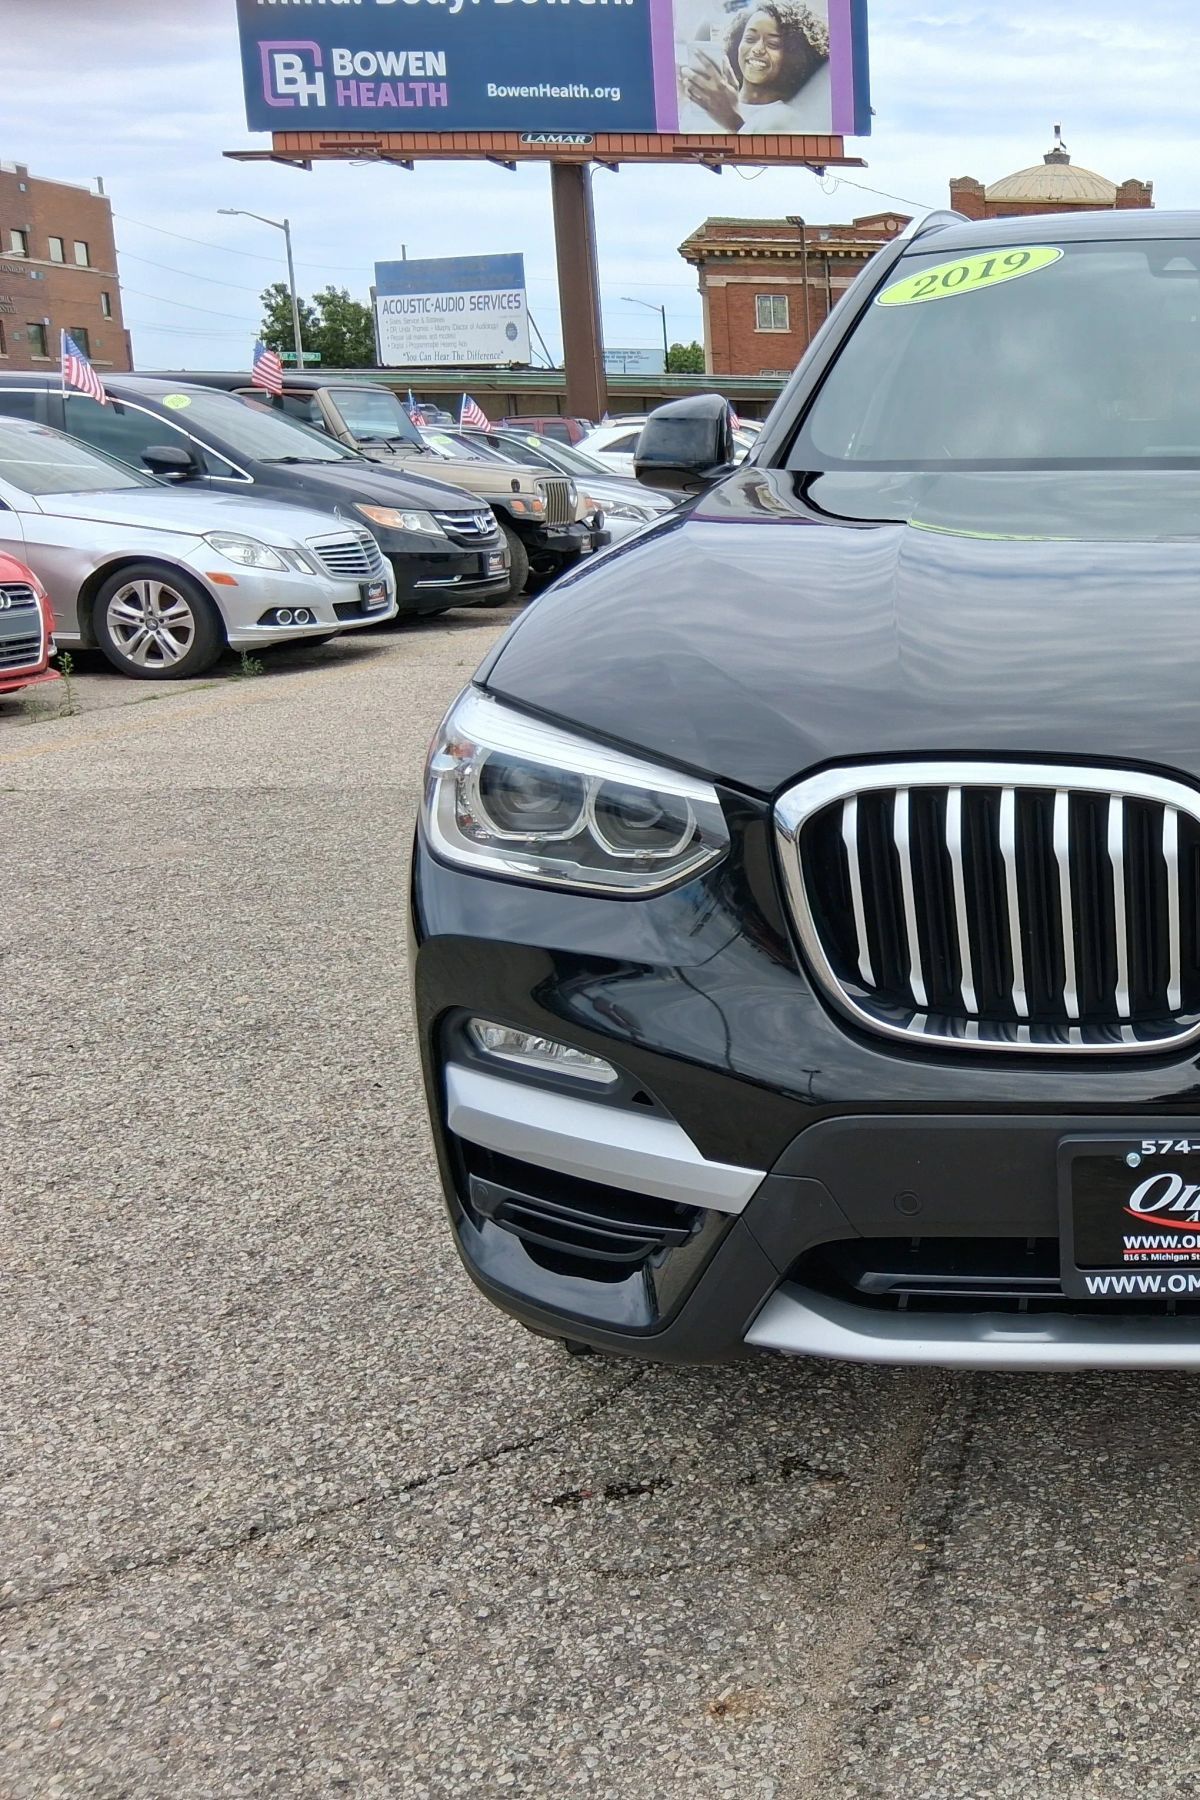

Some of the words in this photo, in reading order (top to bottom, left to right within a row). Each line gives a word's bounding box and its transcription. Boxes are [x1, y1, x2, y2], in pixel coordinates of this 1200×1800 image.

[331, 48, 447, 76] BOWEN
[336, 79, 448, 107] HEALTH
[487, 83, 621, 101] BowenHealth.org
[526, 134, 586, 143] LAMAR
[911, 251, 1031, 299] 2019
[469, 293, 521, 312] SERVICES
[419, 351, 432, 361] Can
[434, 351, 449, 360] Hear
[452, 350, 465, 360] The
[1123, 1253, 1140, 1261] 816
[1141, 1253, 1149, 1261] S.
[1150, 1253, 1190, 1262] Michigan
